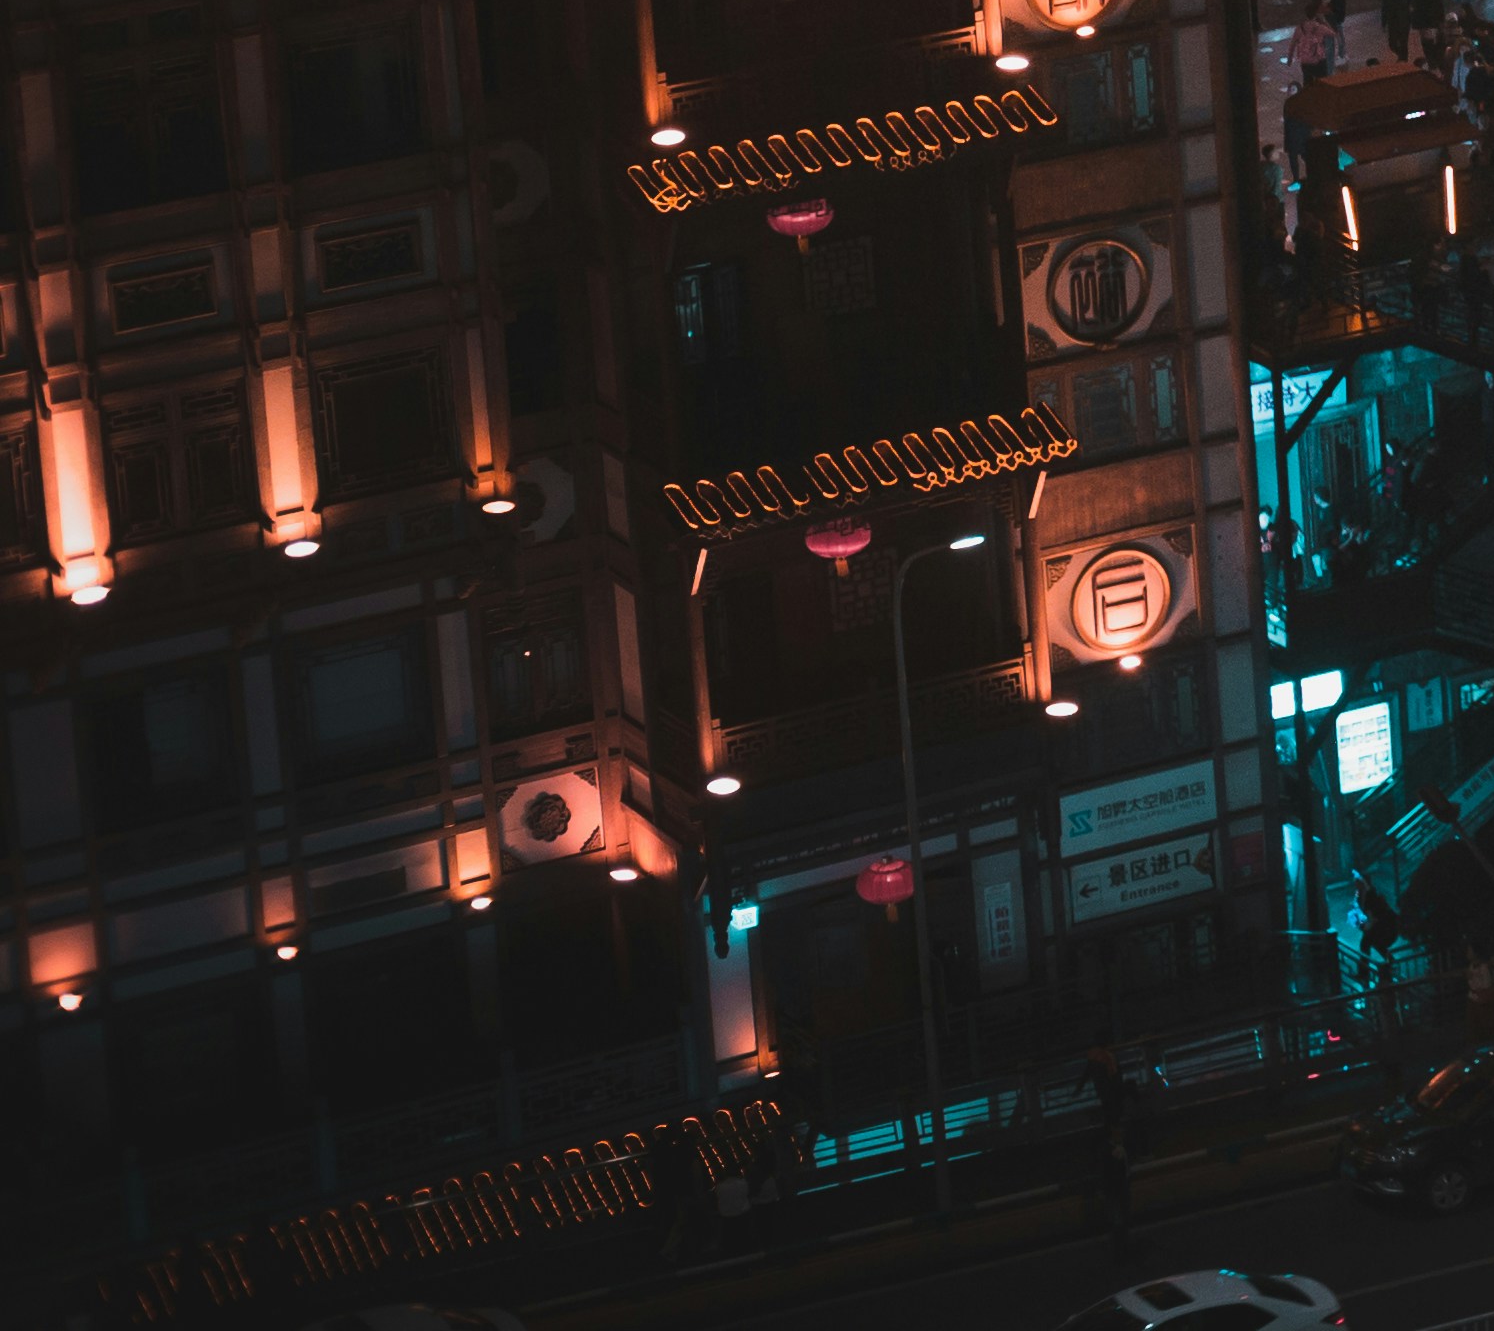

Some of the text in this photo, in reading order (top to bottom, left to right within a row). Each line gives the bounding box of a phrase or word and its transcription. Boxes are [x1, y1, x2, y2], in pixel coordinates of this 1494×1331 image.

[1109, 848, 1191, 888] 景区进口
[1119, 879, 1181, 903] Entrance
